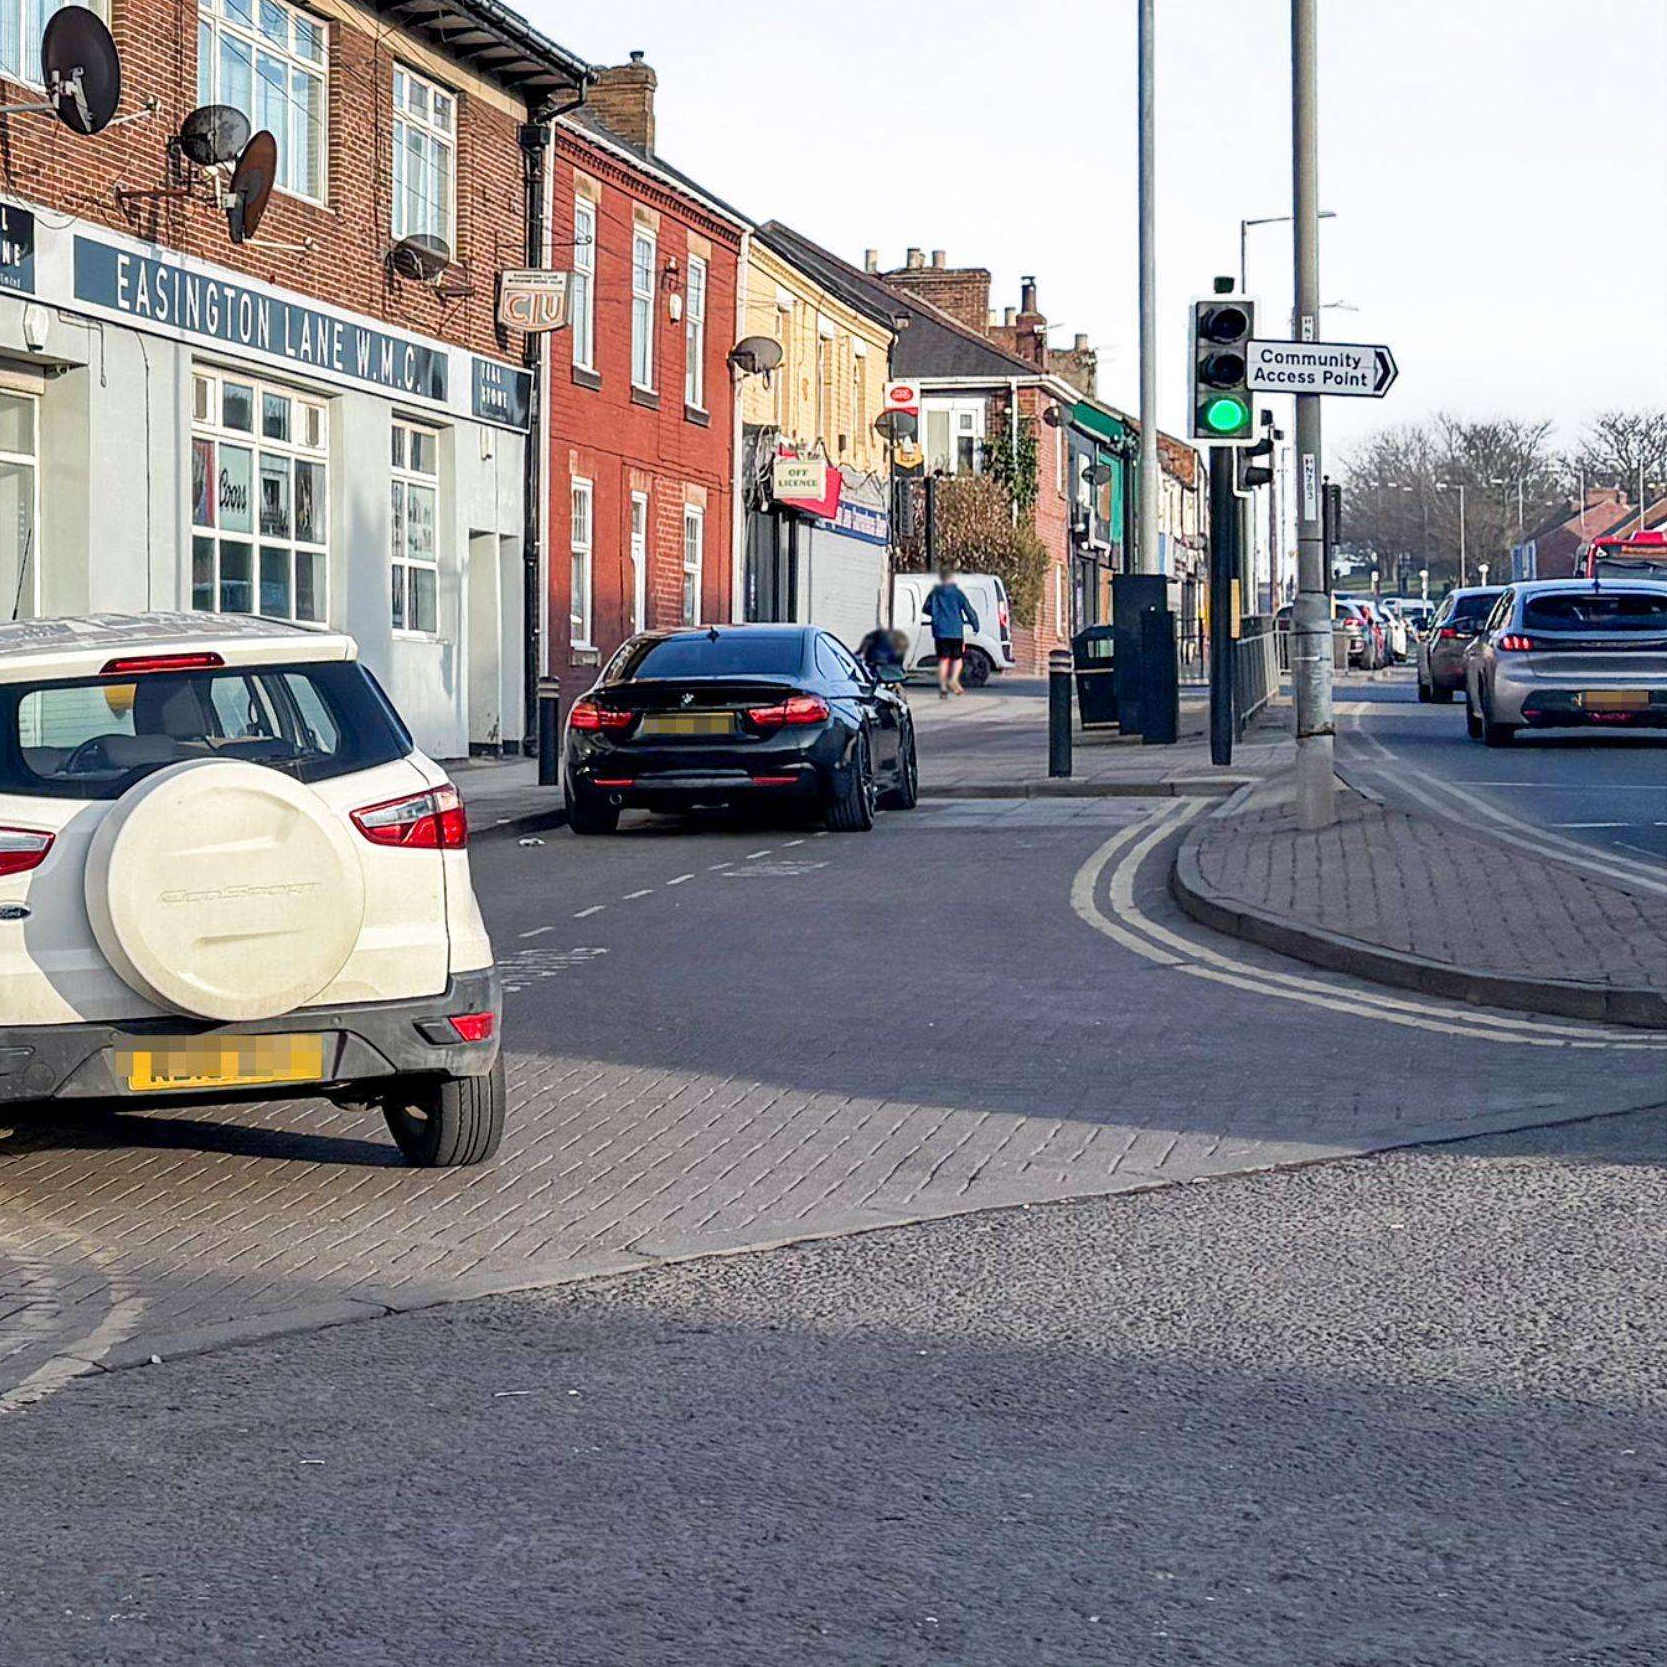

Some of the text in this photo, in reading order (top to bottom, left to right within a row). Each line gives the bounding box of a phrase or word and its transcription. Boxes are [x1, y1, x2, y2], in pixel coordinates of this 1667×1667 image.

[509, 293, 559, 324] CIU
[117, 253, 422, 393] EASINGTON LANE W.M.C.
[1260, 348, 1362, 370] Community
[1254, 367, 1368, 386] Access Point
[788, 468, 809, 477] OFF
